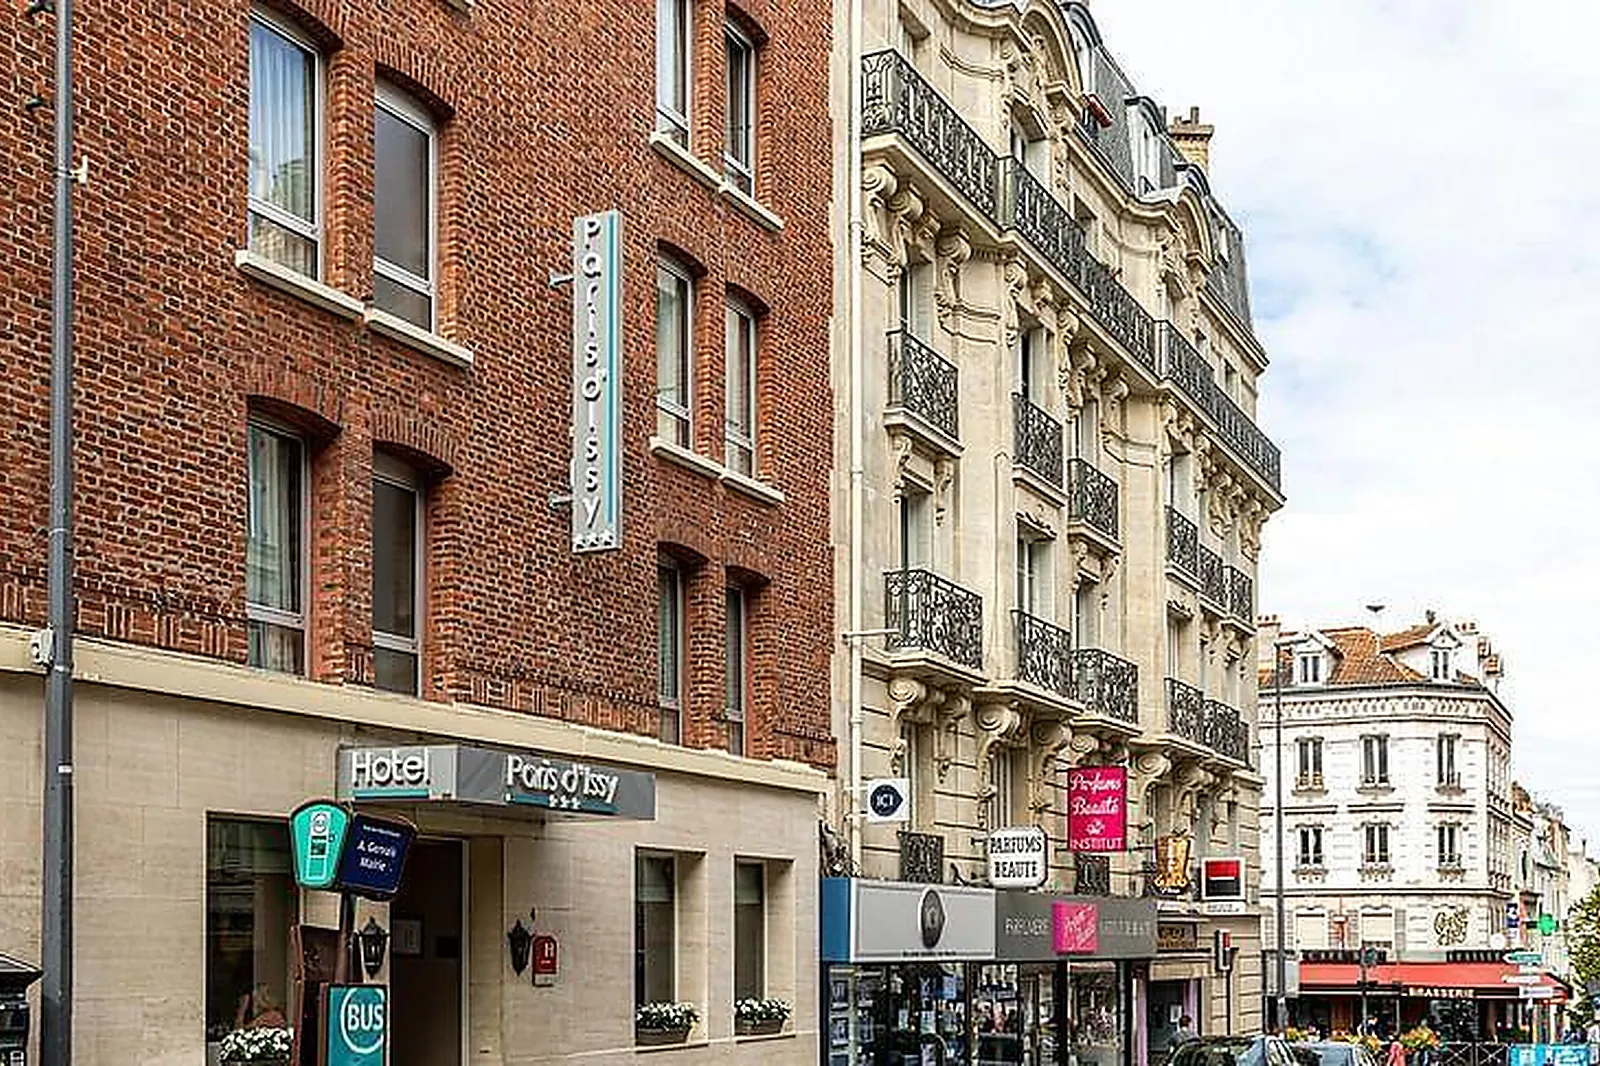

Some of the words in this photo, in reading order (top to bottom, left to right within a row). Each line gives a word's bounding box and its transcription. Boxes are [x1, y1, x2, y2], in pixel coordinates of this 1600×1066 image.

[582, 217, 601, 366] Paris
[352, 748, 429, 786] Hotel
[506, 754, 559, 791] Paris
[560, 763, 619, 804] d'Issy
[990, 836, 1042, 854] PARFUMS
[1072, 837, 1122, 850] INSTITUT
[1408, 987, 1475, 998] BRASSERIE
[347, 1003, 384, 1032] BUS
